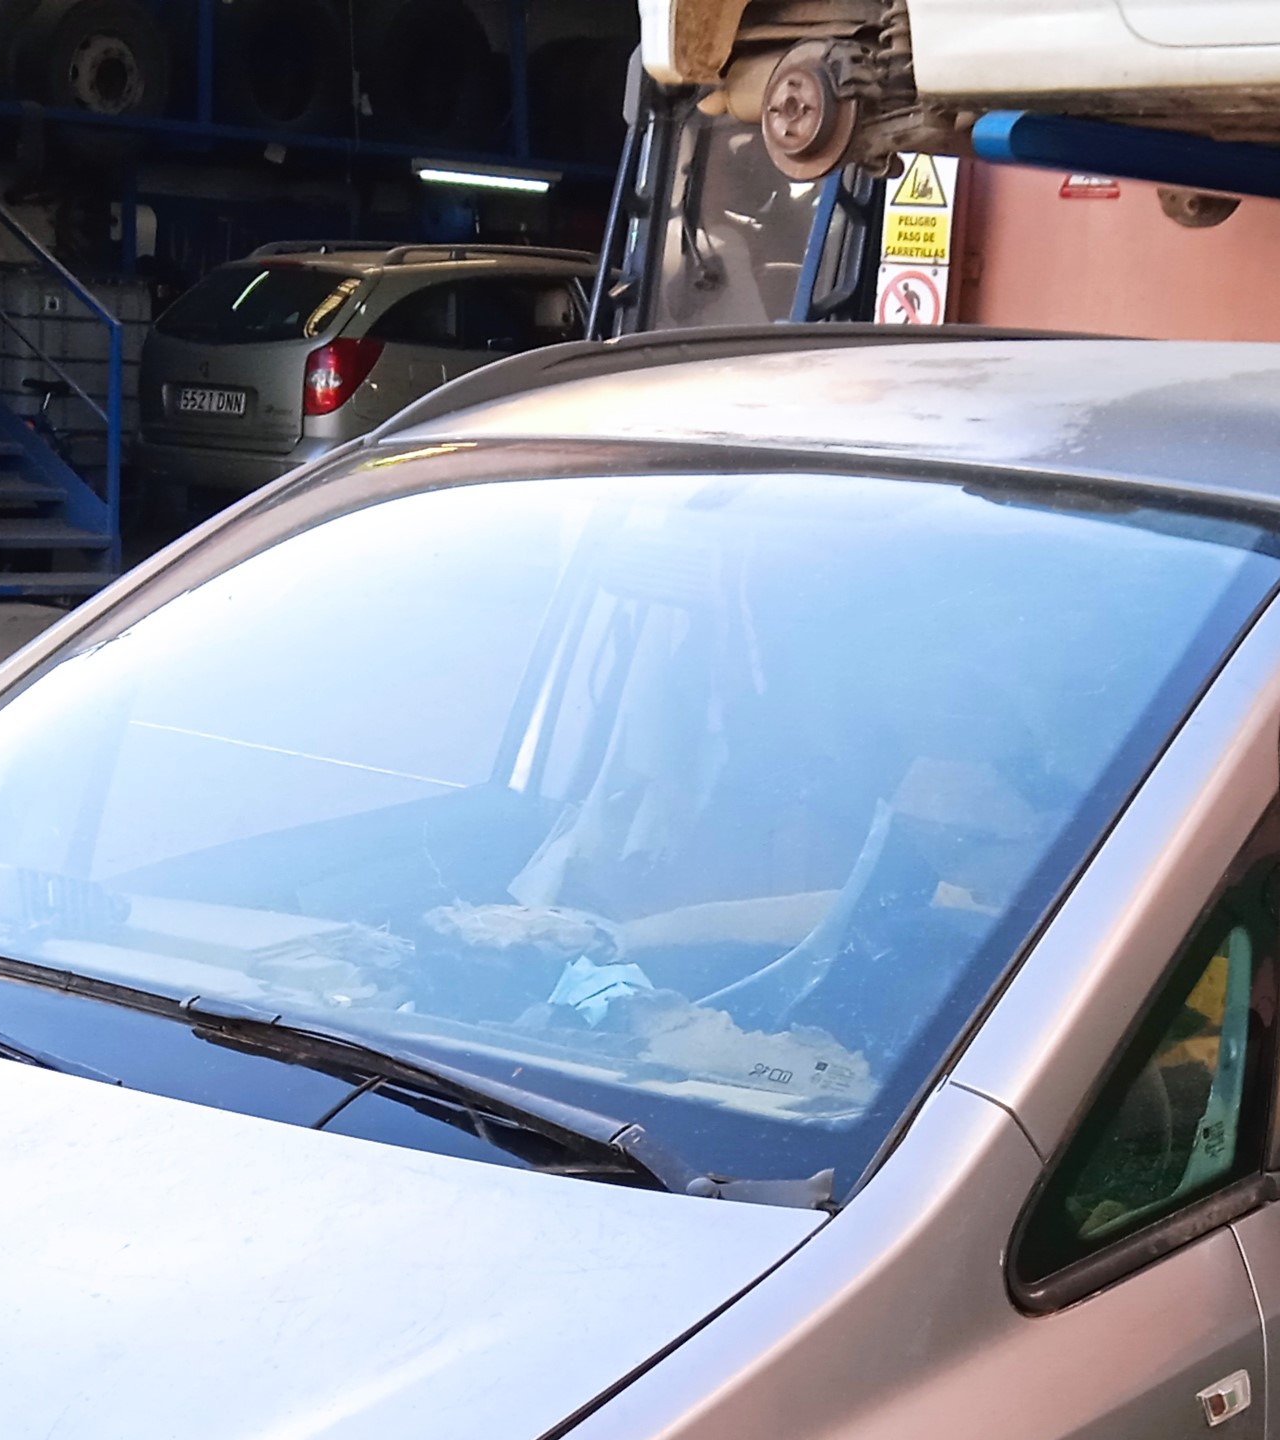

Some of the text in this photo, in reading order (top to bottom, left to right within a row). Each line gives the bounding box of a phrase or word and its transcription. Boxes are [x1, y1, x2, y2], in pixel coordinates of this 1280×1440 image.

[898, 215, 936, 227] PELIGRO
[896, 231, 935, 243] PASO DE
[885, 246, 945, 258] CARRETILLAS
[182, 388, 214, 410] 5521
[217, 391, 242, 412] DNN
